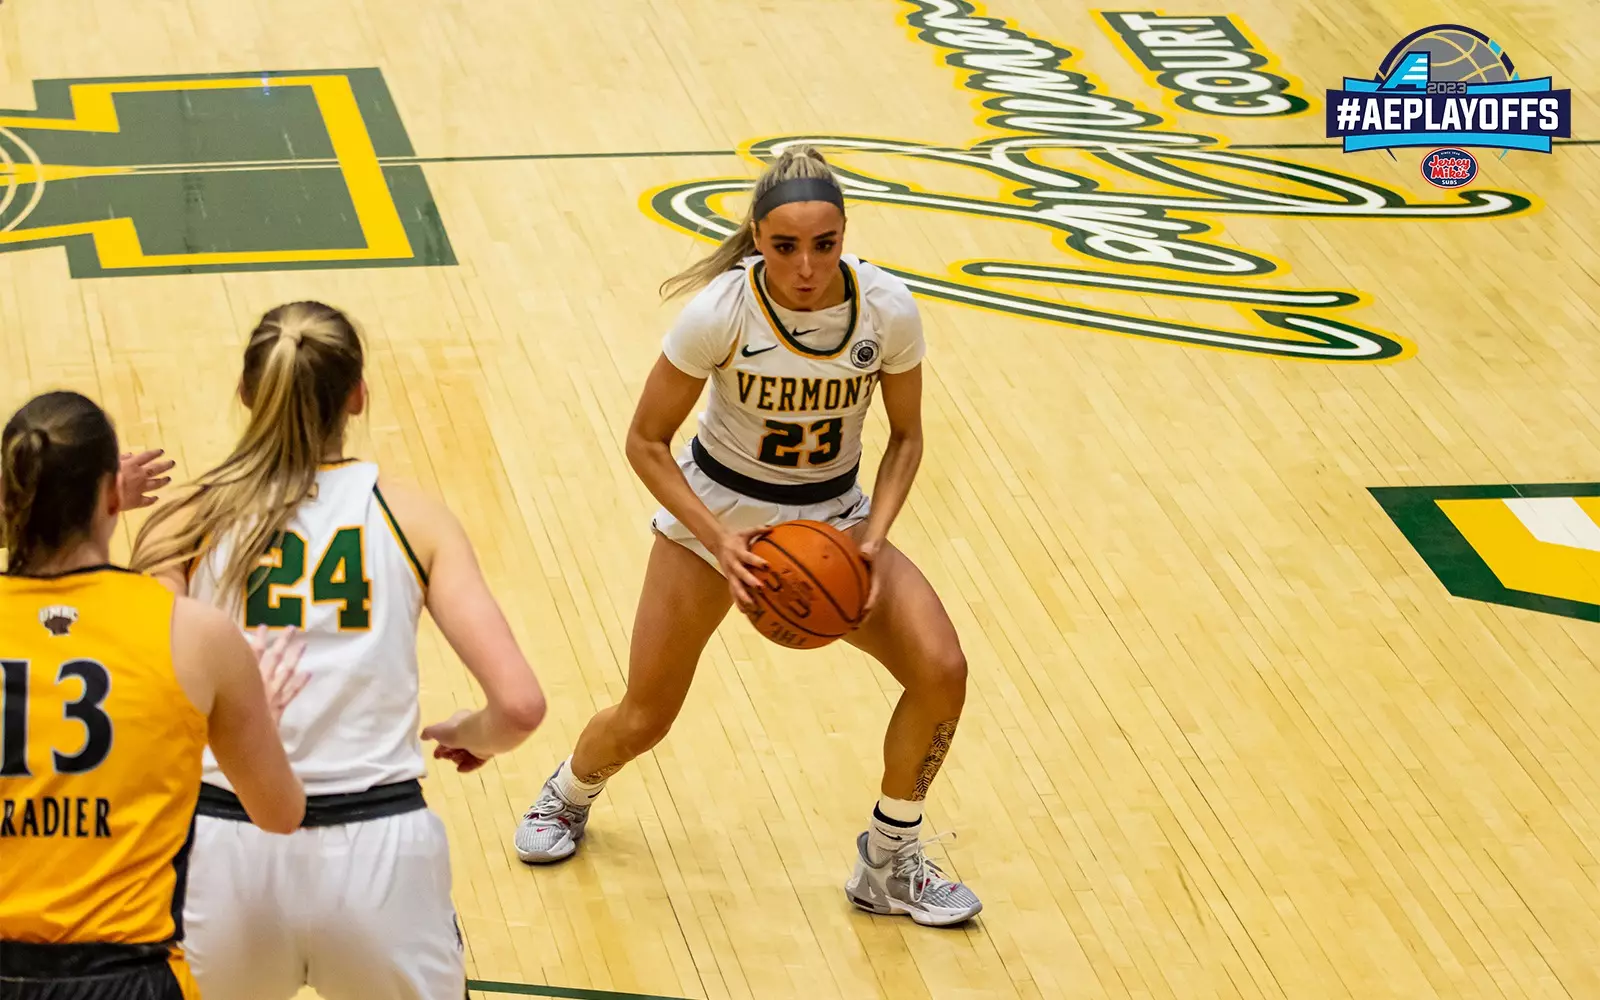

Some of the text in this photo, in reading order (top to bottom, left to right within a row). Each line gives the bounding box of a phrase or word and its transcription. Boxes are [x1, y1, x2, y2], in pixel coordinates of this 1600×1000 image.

[1113, 12, 1296, 116] COURT
[736, 371, 877, 412] VERMONT
[758, 417, 844, 468] 23
[243, 525, 373, 632] 24
[0, 657, 114, 777] 13
